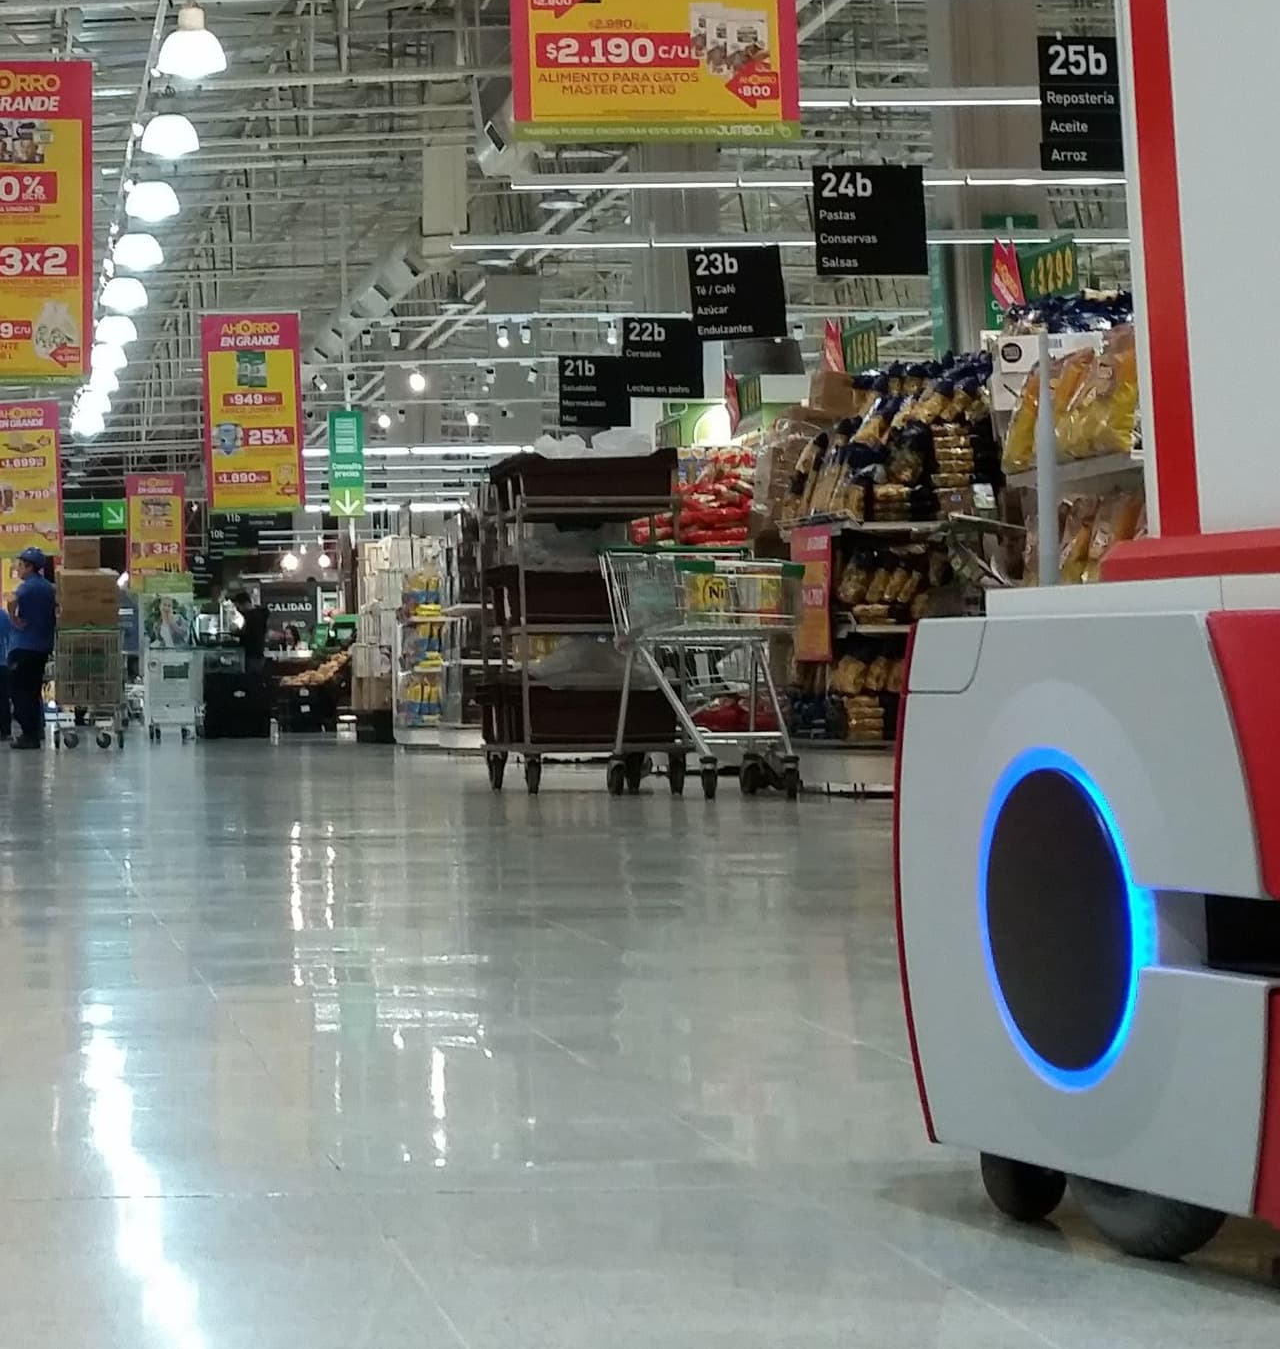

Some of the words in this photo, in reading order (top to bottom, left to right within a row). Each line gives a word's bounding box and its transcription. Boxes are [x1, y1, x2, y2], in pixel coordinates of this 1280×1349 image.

[545, 37, 655, 64] $2.190
[1048, 44, 1108, 76] 25b
[537, 72, 610, 84] ALIMENTO
[613, 72, 650, 83] PARA
[653, 72, 699, 83] GATOS
[561, 84, 616, 96] MASTER
[621, 84, 645, 96] CAT
[658, 84, 677, 96] KG
[1046, 91, 1115, 108] Repostería
[1050, 119, 1089, 133] Aceite
[1051, 148, 1089, 162] Arroz
[821, 171, 873, 198] 24b
[819, 209, 857, 221] Pastas
[820, 233, 878, 244] Conservas
[0, 246, 68, 276] 3x2
[694, 252, 739, 276] 23b
[821, 256, 859, 268] Salsas
[695, 284, 706, 296] Té
[714, 283, 736, 295] Café
[697, 304, 729, 316] Azúcar
[221, 319, 280, 336] AHORRO
[628, 321, 666, 342] 22b
[697, 323, 754, 336] Endulzantes
[220, 336, 236, 347] EN
[237, 335, 280, 347] GRANDE
[564, 359, 596, 377] 21b
[266, 602, 313, 613] CALIDAD
